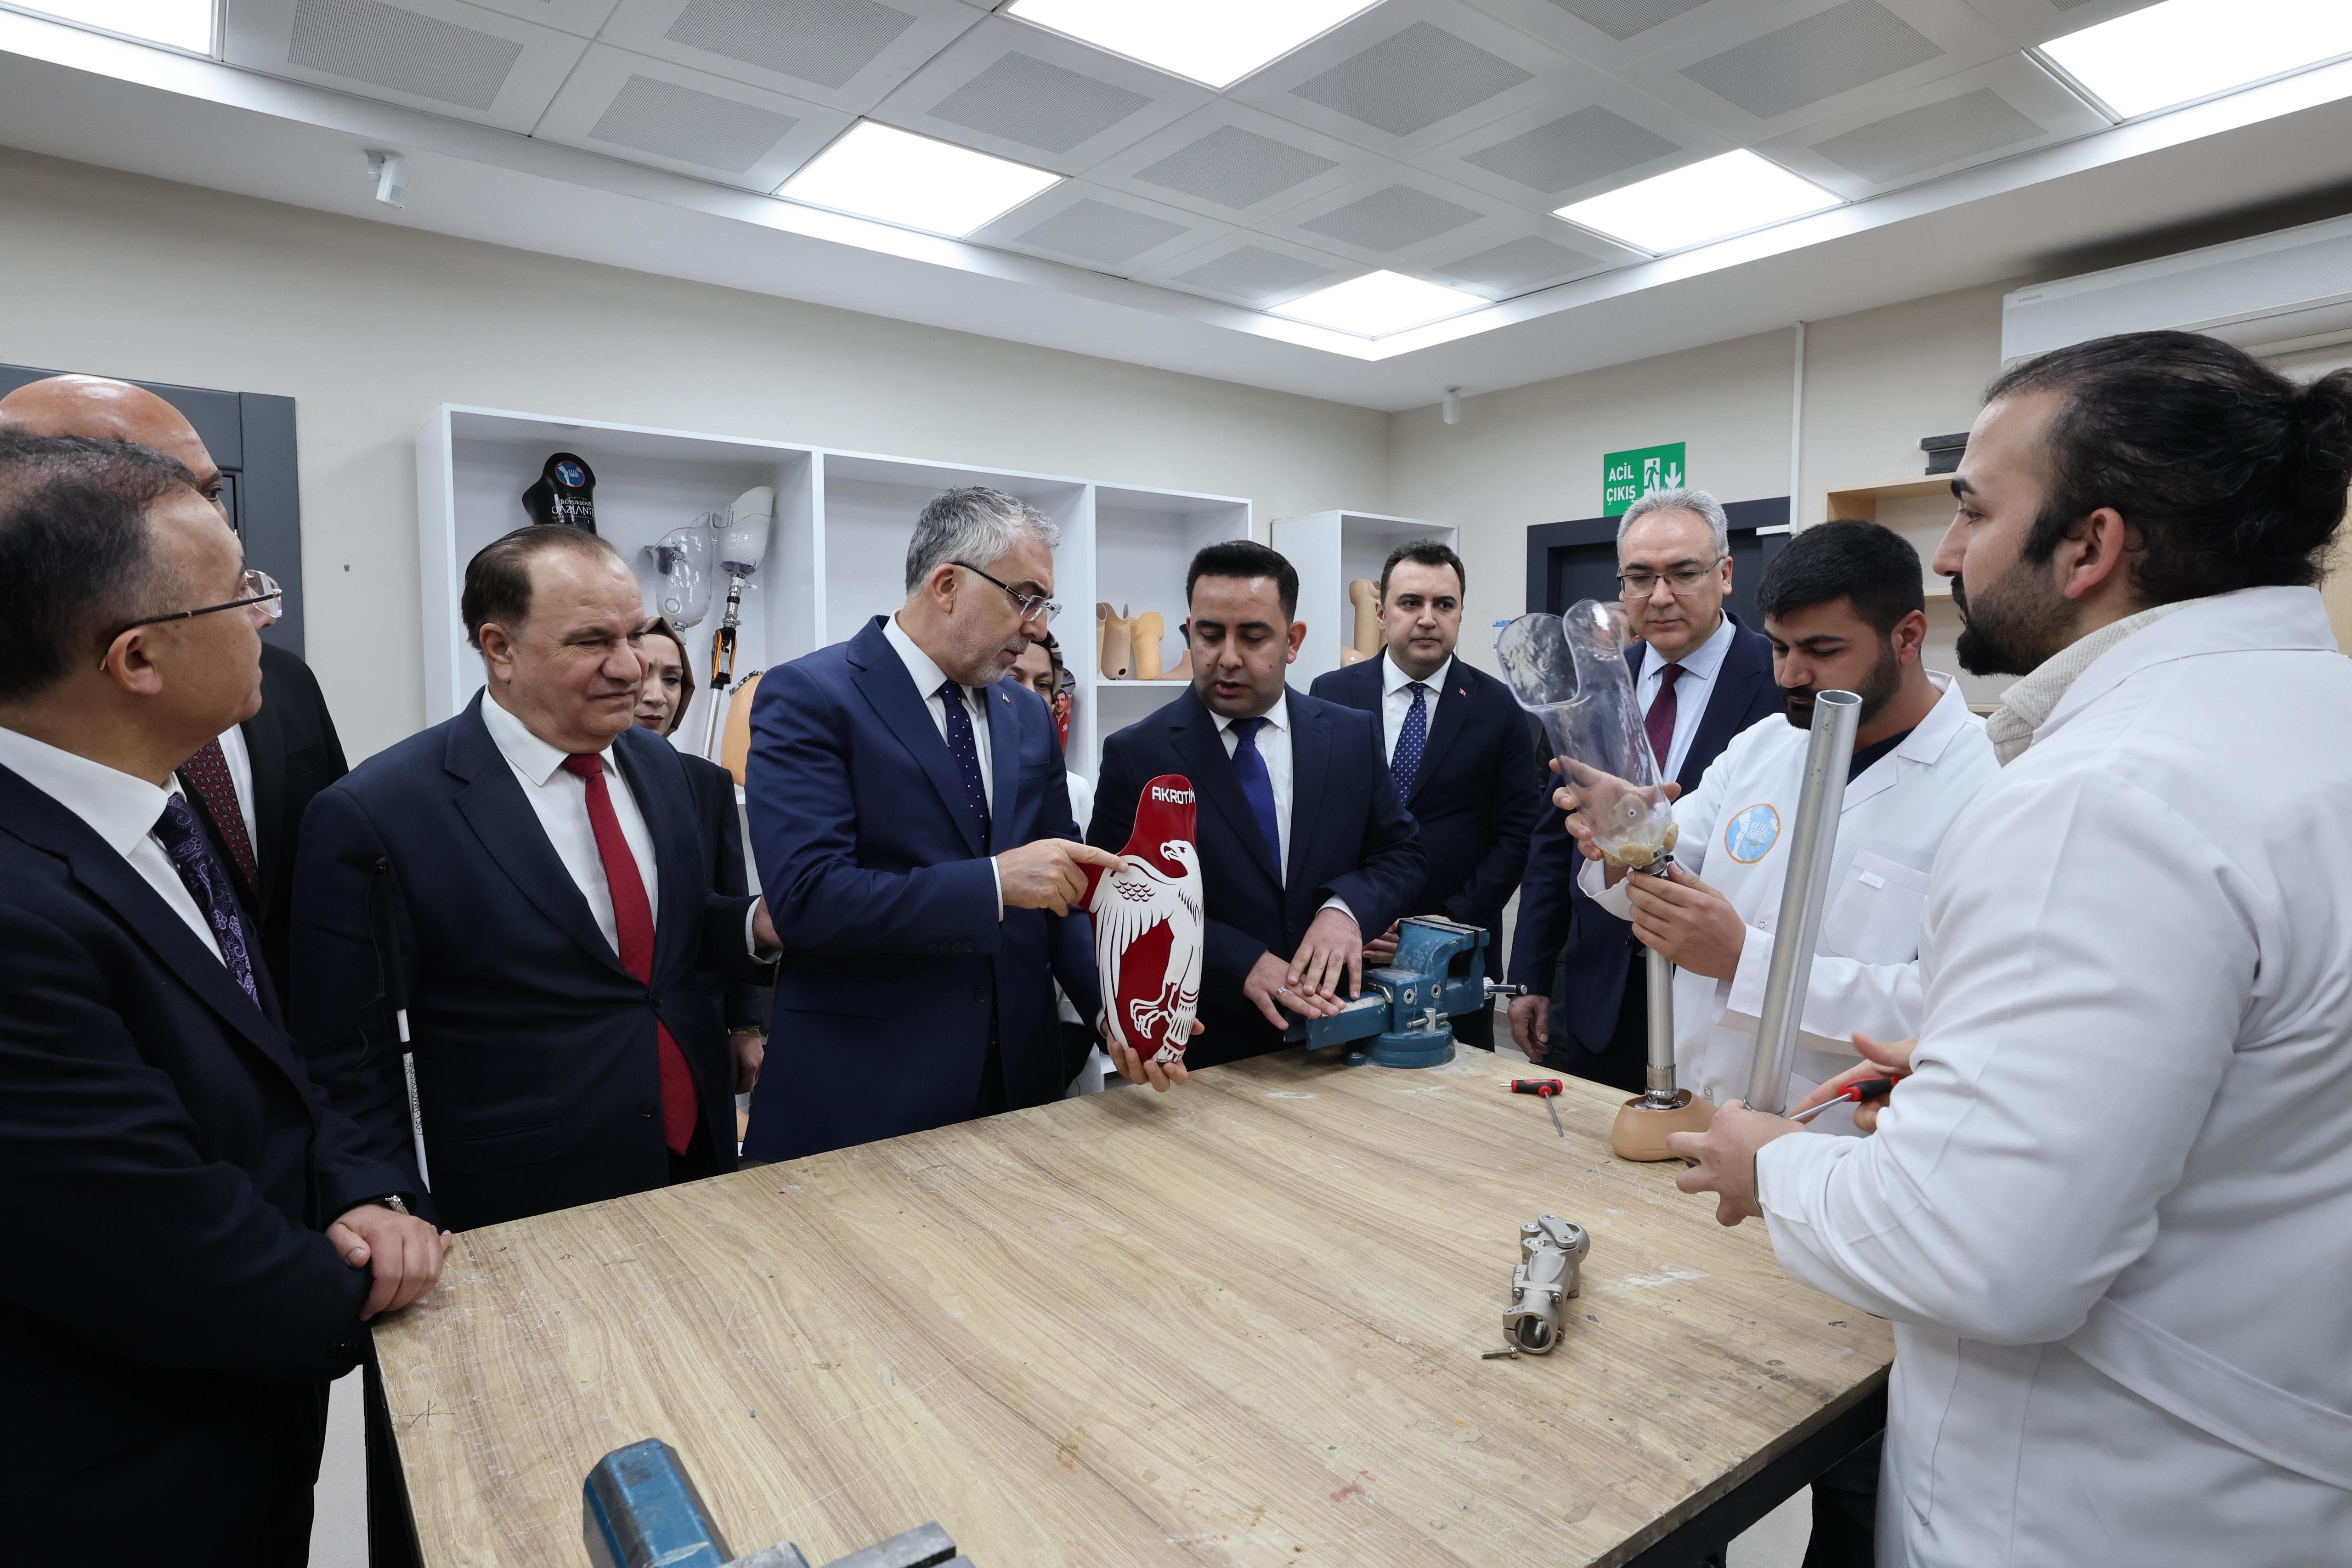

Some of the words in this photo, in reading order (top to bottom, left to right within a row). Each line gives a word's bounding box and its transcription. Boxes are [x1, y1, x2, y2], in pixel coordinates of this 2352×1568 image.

[1608, 463, 1634, 482] ACİL
[1606, 485, 1636, 506] ÇIKIŞ
[1152, 786, 1196, 805] AKROTİM
